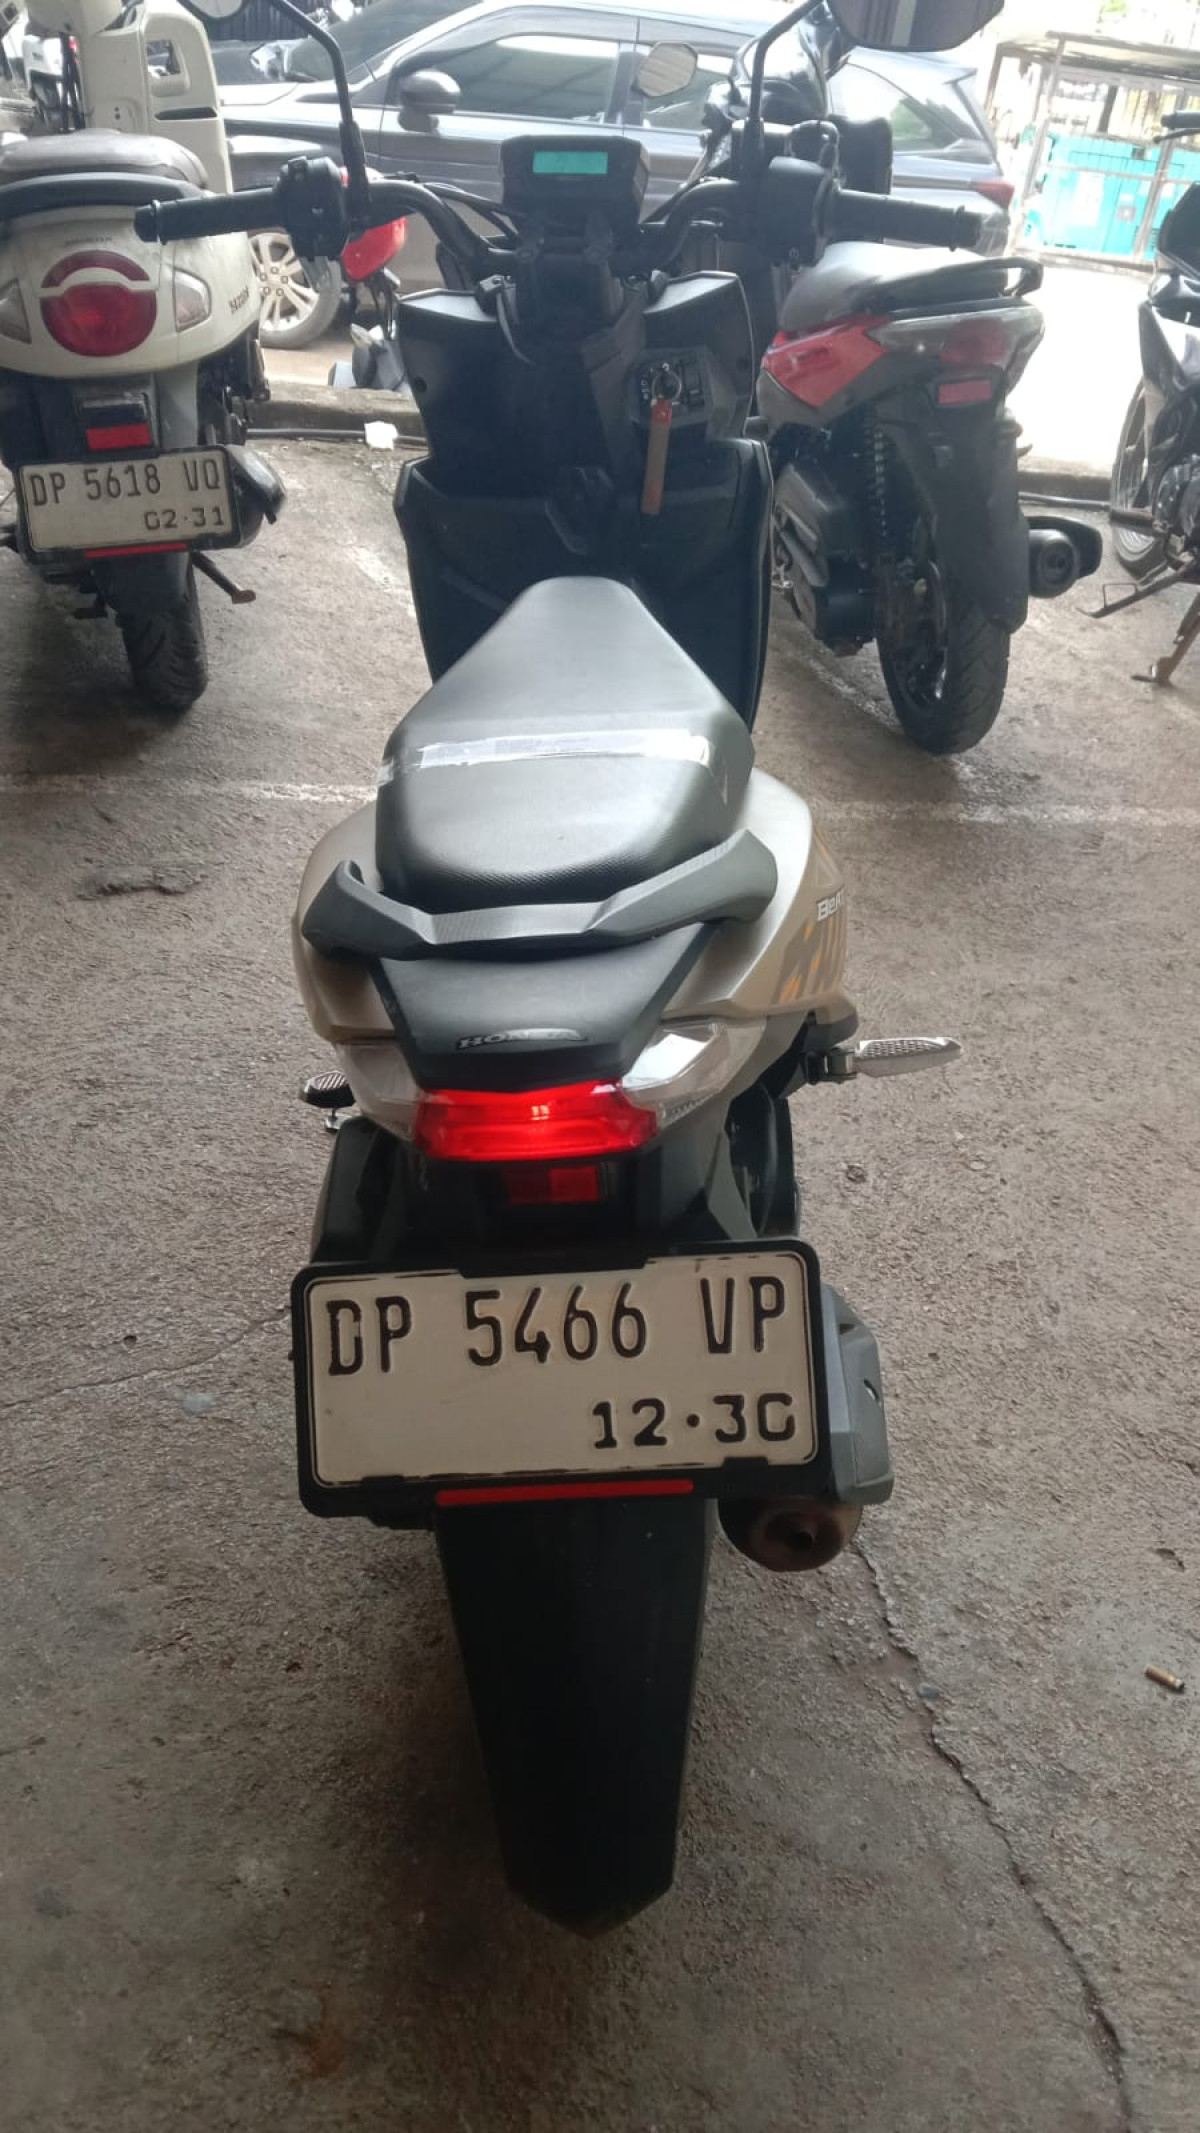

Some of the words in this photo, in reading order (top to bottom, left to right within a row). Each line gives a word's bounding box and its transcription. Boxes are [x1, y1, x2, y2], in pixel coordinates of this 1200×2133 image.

[29, 471, 66, 506] DP
[83, 463, 161, 501] 5618
[183, 458, 221, 492] VQ
[456, 1028, 588, 1051] HONA
[326, 1296, 412, 1376] DP
[465, 1282, 647, 1366] 5466
[700, 1276, 785, 1355] VP
